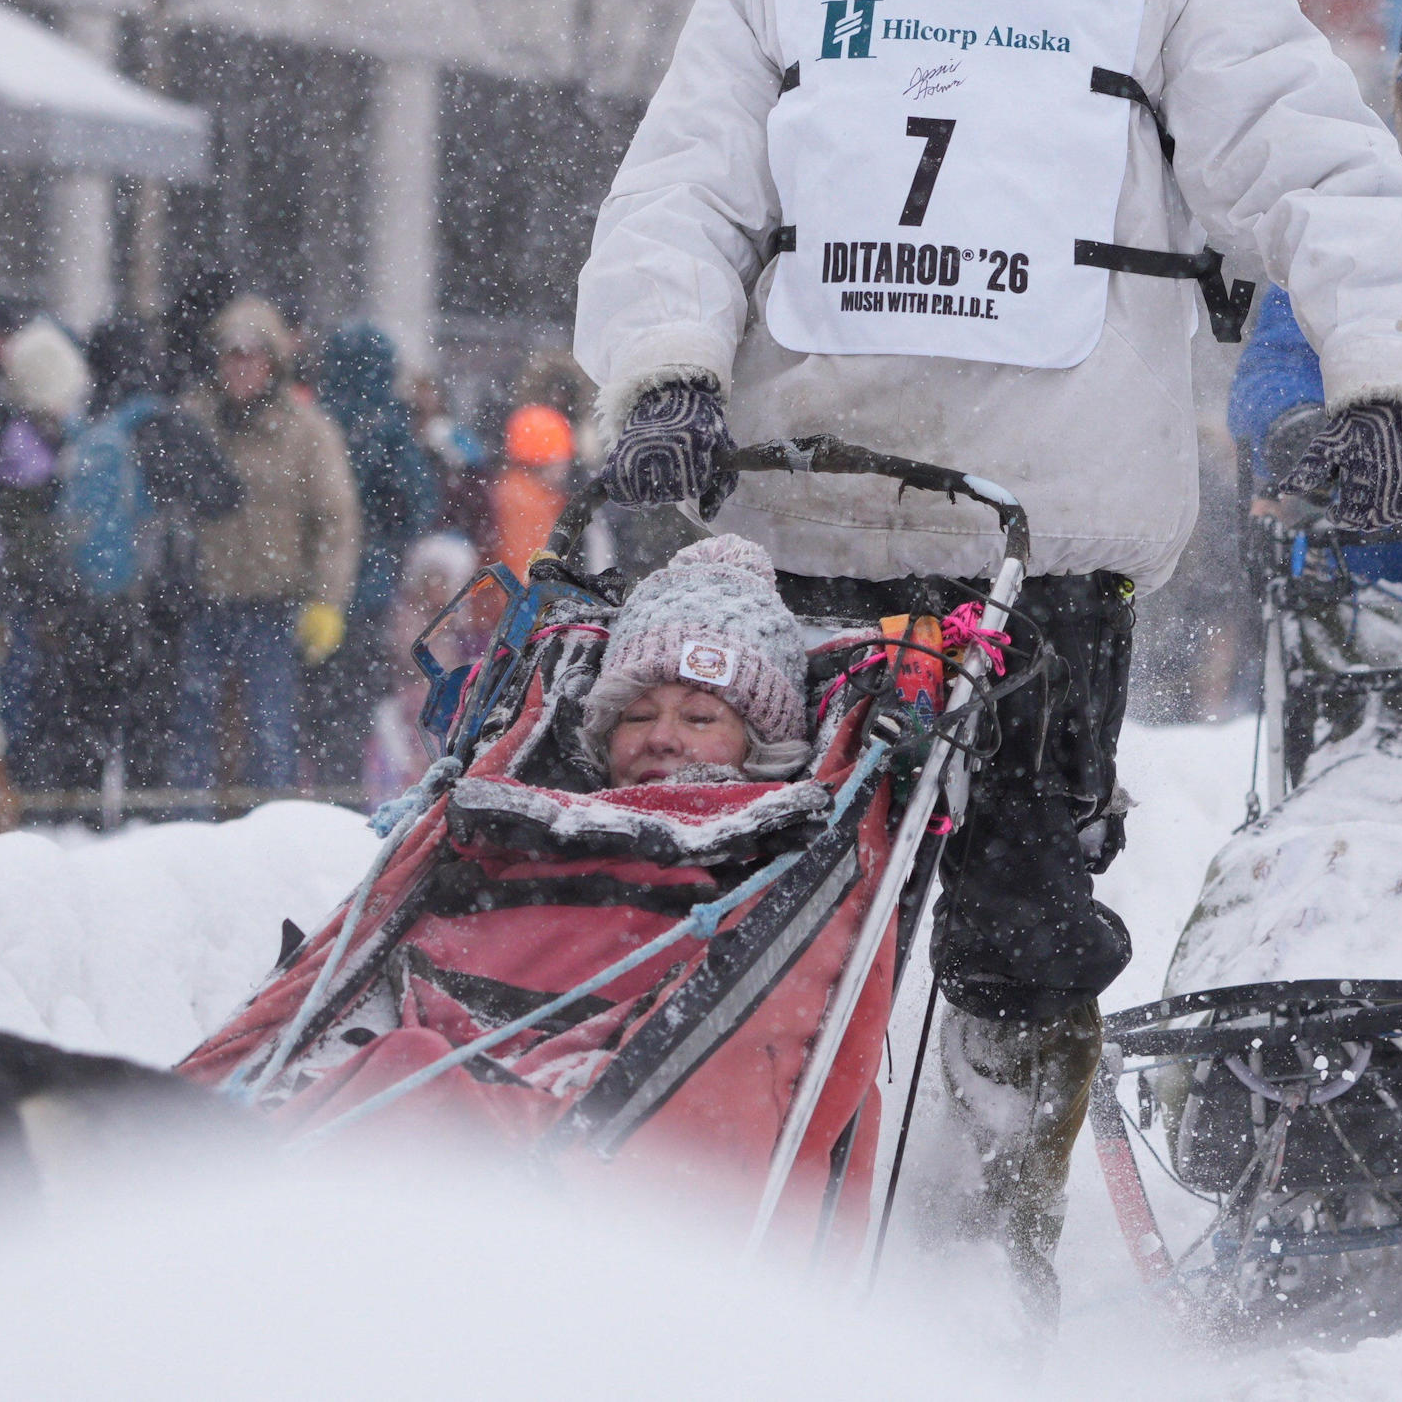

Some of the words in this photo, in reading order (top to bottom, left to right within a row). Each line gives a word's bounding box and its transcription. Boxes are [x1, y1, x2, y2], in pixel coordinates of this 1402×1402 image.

[881, 18, 977, 50] Hilcorp
[984, 25, 1071, 53] Alaska
[898, 116, 957, 227] 7
[841, 290, 884, 312] MUSH
[887, 291, 928, 314] WITH
[931, 293, 999, 320] P.R.I.D.E.
